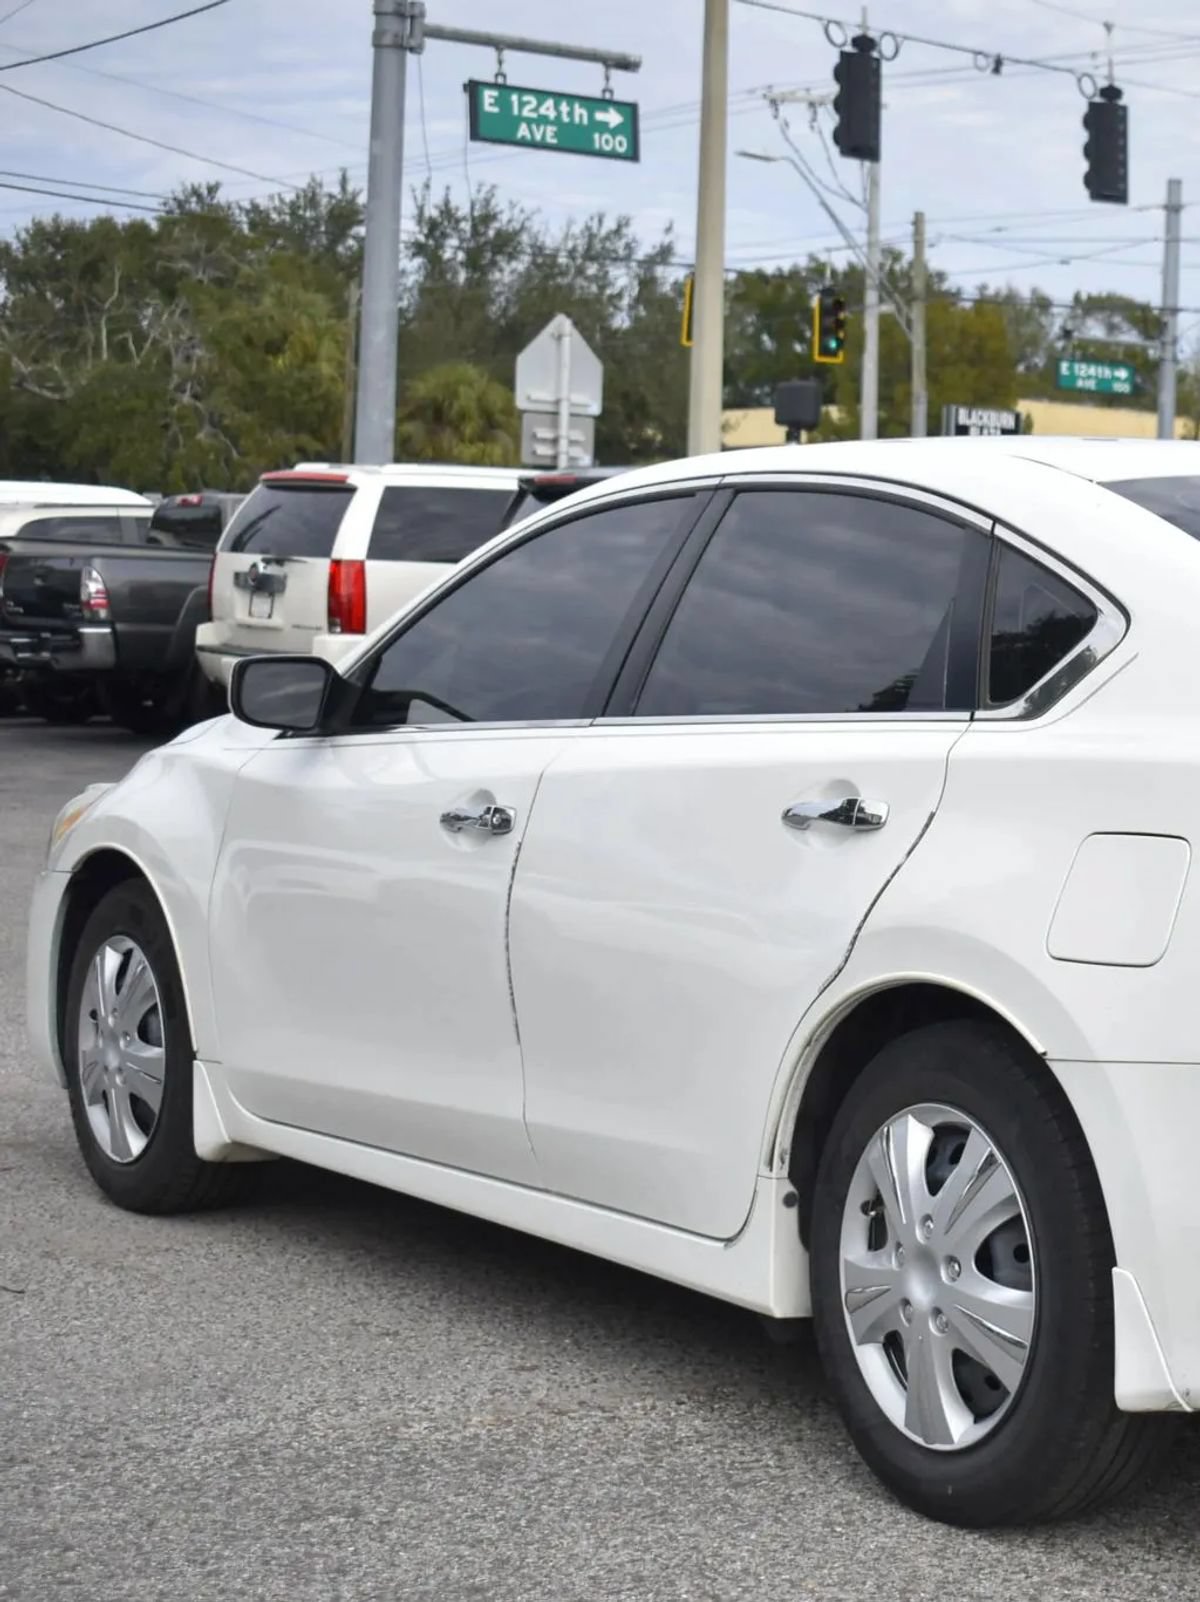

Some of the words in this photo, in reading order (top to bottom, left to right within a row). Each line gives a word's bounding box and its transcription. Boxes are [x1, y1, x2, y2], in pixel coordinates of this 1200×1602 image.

[483, 90, 499, 113] E
[511, 94, 588, 125] 124th
[517, 122, 558, 144] AVE
[593, 133, 628, 153] 100
[1060, 361, 1070, 376] E
[1074, 362, 1112, 380] 124th
[958, 407, 1016, 430] BLACKBURN
